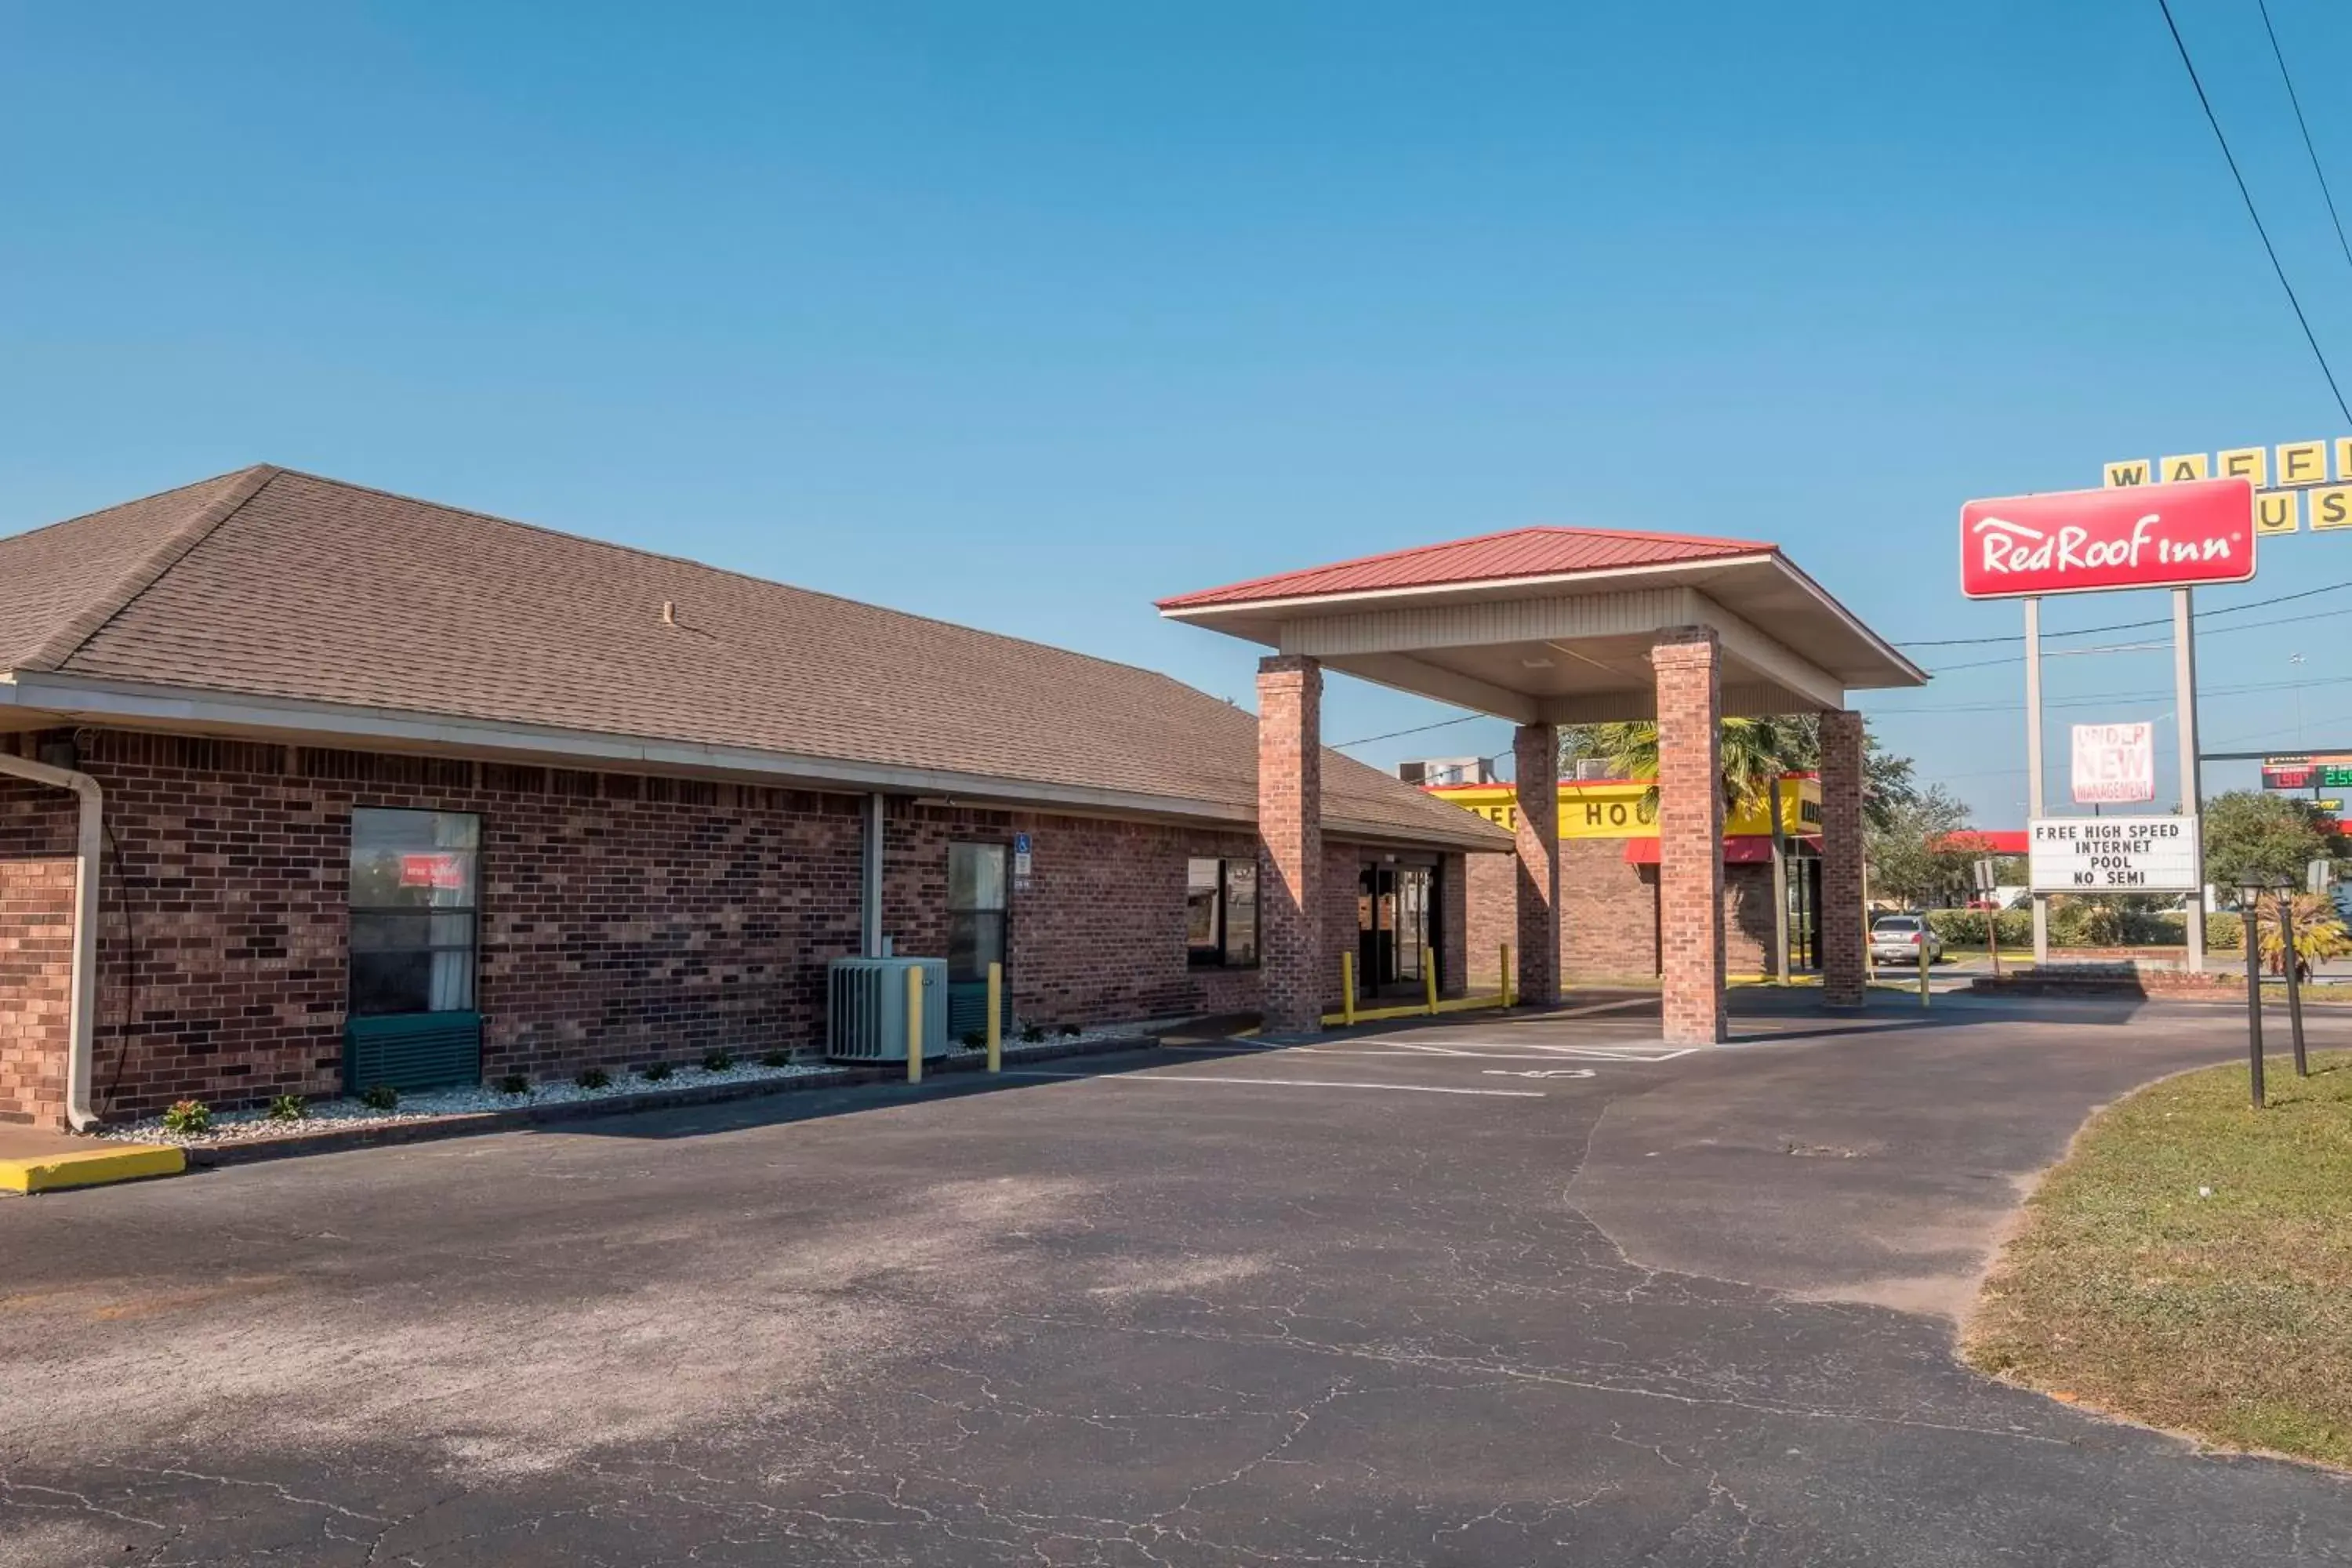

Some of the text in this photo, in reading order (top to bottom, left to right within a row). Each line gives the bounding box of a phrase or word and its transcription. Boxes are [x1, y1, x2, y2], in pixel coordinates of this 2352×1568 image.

[2078, 748, 2147, 779] NEW
[2036, 824, 2179, 840] FREE HIGH SPEED
[2075, 840, 2152, 854] INTERNET
[2091, 856, 2132, 869] POOL
[2074, 871, 2145, 884] NO SEMI
